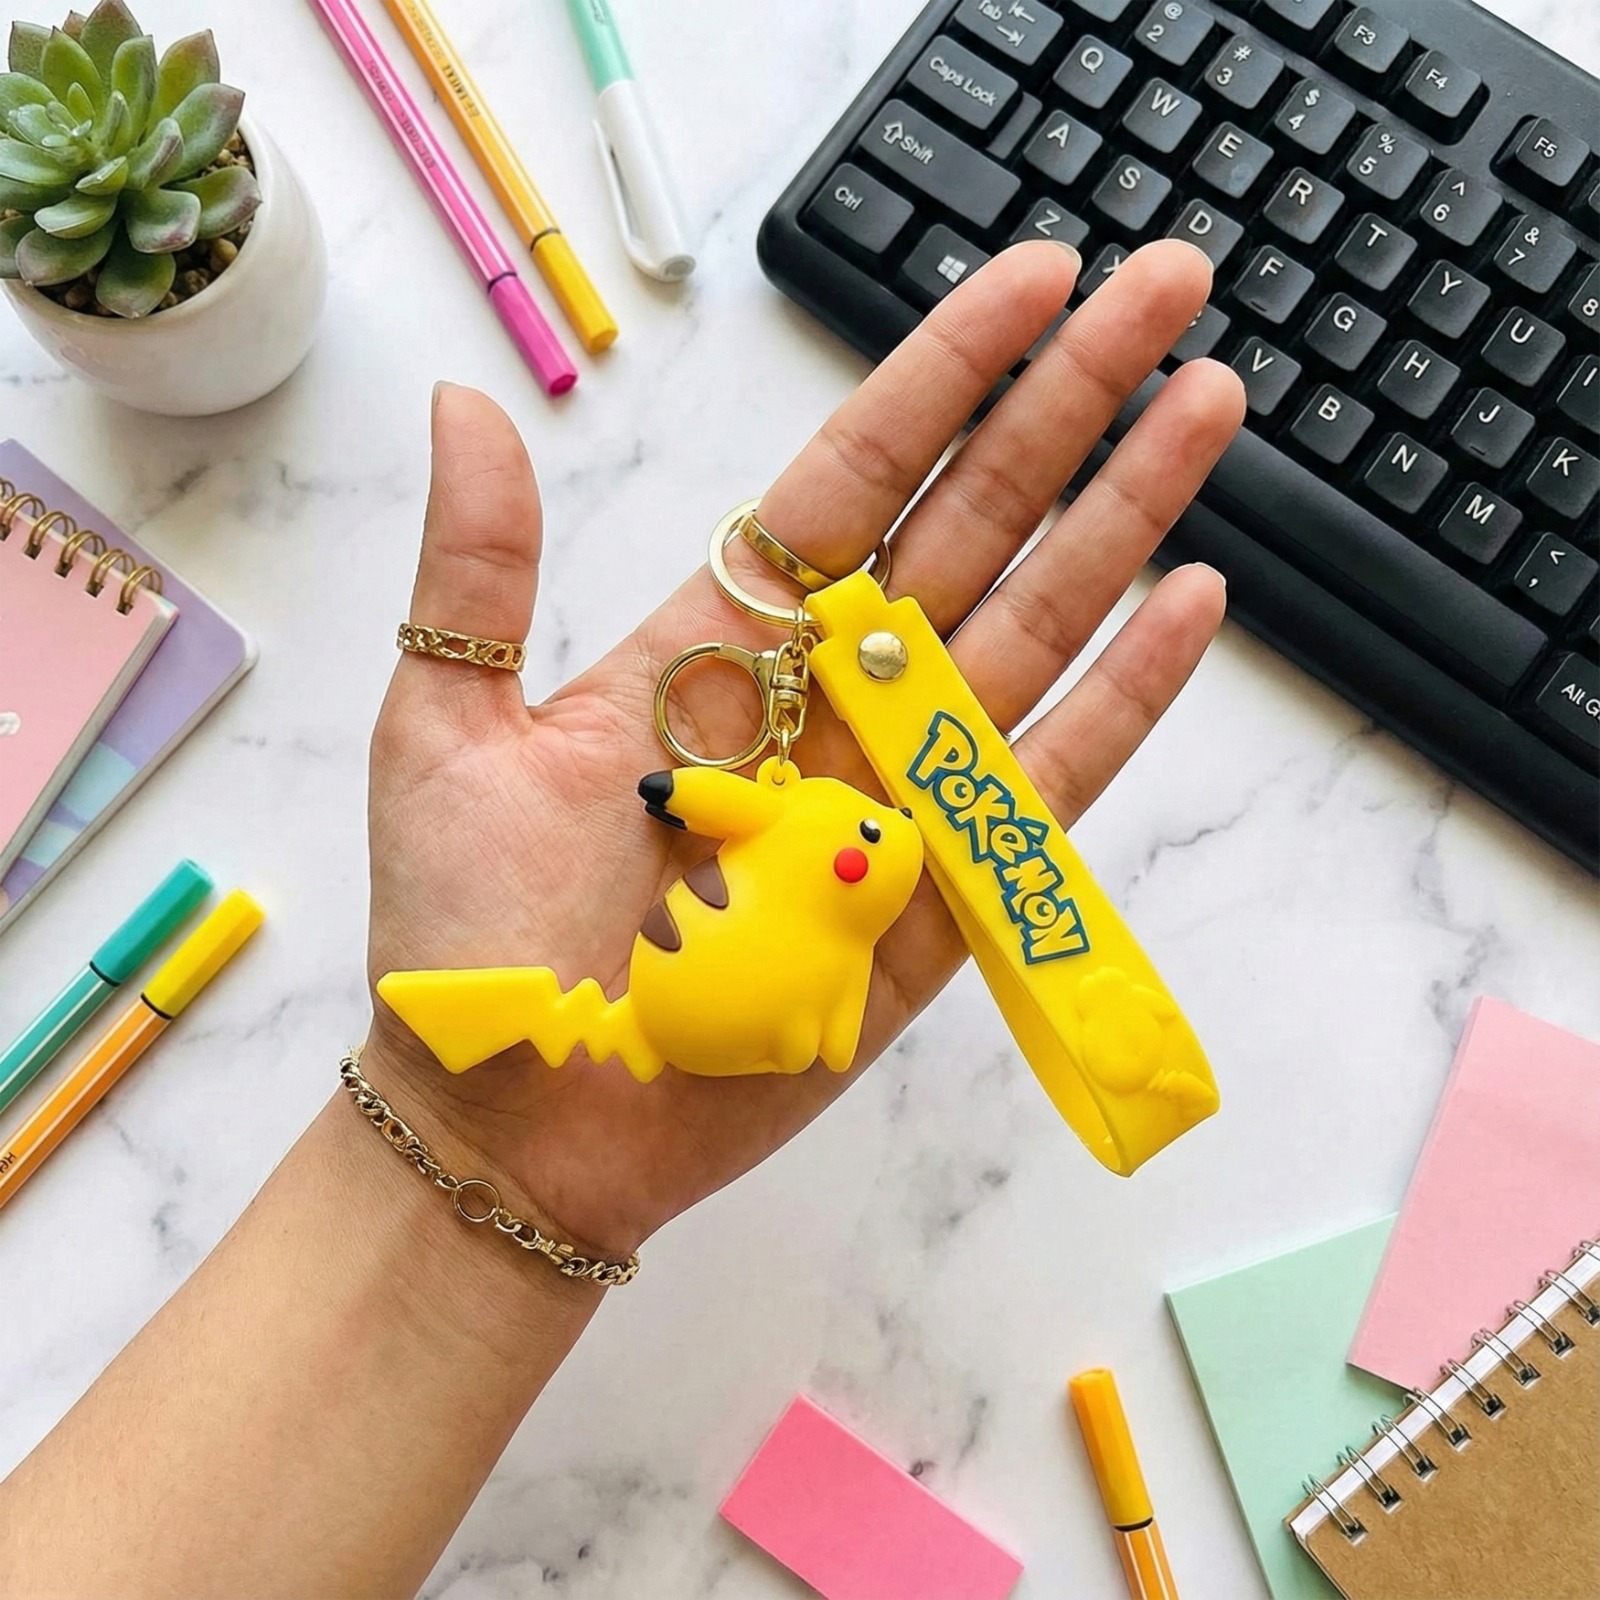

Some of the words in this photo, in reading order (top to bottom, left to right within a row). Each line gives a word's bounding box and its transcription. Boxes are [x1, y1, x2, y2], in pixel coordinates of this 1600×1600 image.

[1164, 2, 1183, 20] @
[1146, 24, 1164, 42] 2
[1353, 24, 1376, 45] F3
[1080, 46, 1104, 73] Q
[1234, 45, 1252, 61] #
[929, 56, 964, 86] Caps
[961, 77, 997, 107] Lock
[1216, 67, 1233, 85] 3
[1426, 68, 1448, 90] F4
[1151, 88, 1181, 116] W
[1288, 114, 1305, 130] 4
[1047, 123, 1070, 148] A
[1218, 132, 1243, 158] E
[1378, 133, 1396, 154] %
[1534, 136, 1558, 157] F5
[900, 134, 934, 165] Shift
[1359, 156, 1377, 175] 5
[1119, 166, 1141, 190] S
[834, 186, 863, 210] Ctrl
[1288, 177, 1313, 205] R
[1035, 209, 1061, 236] Z
[1188, 210, 1213, 235] D
[1433, 203, 1450, 221] 6
[1367, 223, 1388, 247] T
[1524, 227, 1540, 246] &
[1259, 256, 1284, 276] F
[1508, 248, 1526, 265] 7
[1440, 271, 1463, 295] Y
[1333, 306, 1357, 332] G
[1582, 298, 1599, 316] 8
[1510, 318, 1535, 343] U
[1252, 348, 1274, 372] V
[1403, 351, 1431, 378] H
[1318, 396, 1341, 421] B
[1478, 405, 1501, 423] J
[1391, 444, 1418, 472] N
[1552, 448, 1579, 476] K
[1465, 494, 1496, 524] M
[1561, 683, 1586, 705] Alt
[1585, 698, 1600, 720] G
